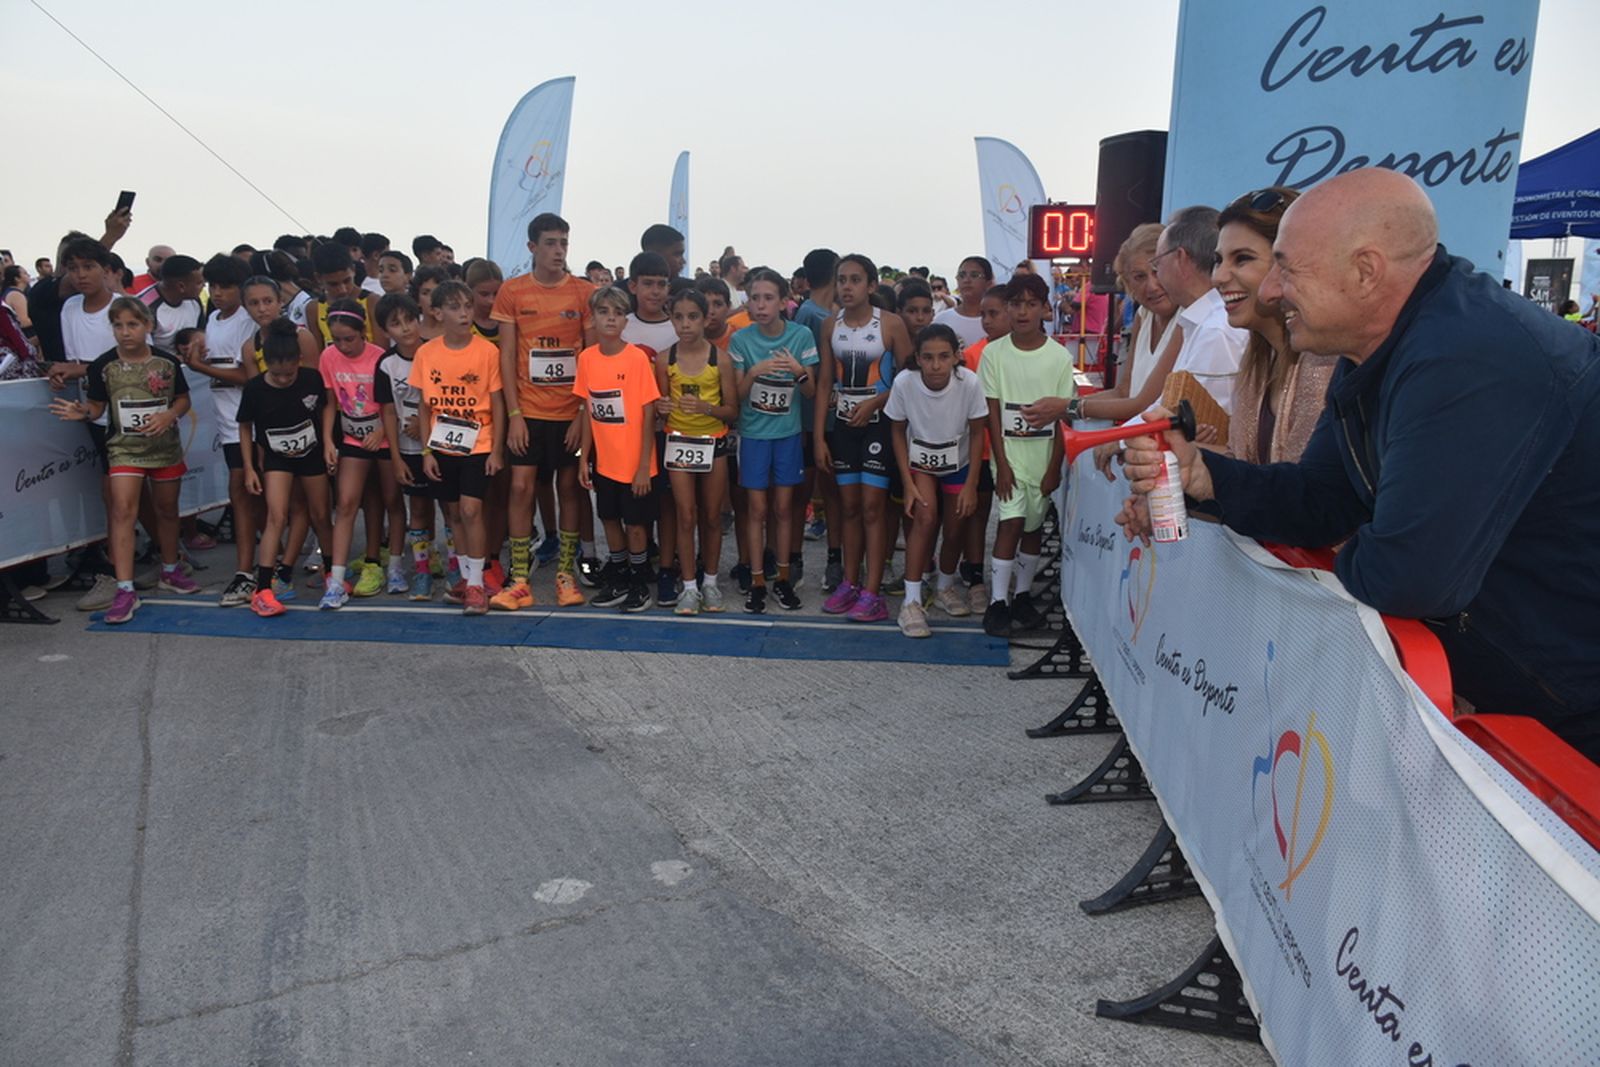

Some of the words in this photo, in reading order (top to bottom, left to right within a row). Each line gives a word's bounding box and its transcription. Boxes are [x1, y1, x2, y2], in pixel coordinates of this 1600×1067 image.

[1494, 37, 1530, 76] es
[1570, 200, 1577, 208] Y
[1540, 212, 1550, 220] DE
[1552, 210, 1588, 219] EVENTOS
[1529, 288, 1550, 301] SAM
[539, 336, 561, 347] TRI
[545, 363, 564, 377] 48
[441, 386, 465, 395] TRI
[430, 397, 477, 407] DINGO
[760, 391, 787, 408] 318
[1013, 416, 1031, 431] 3
[280, 435, 308, 452] 327
[445, 431, 464, 444] 44
[675, 449, 704, 464] 293
[919, 452, 948, 466] 381
[1194, 658, 1238, 717] Deporte
